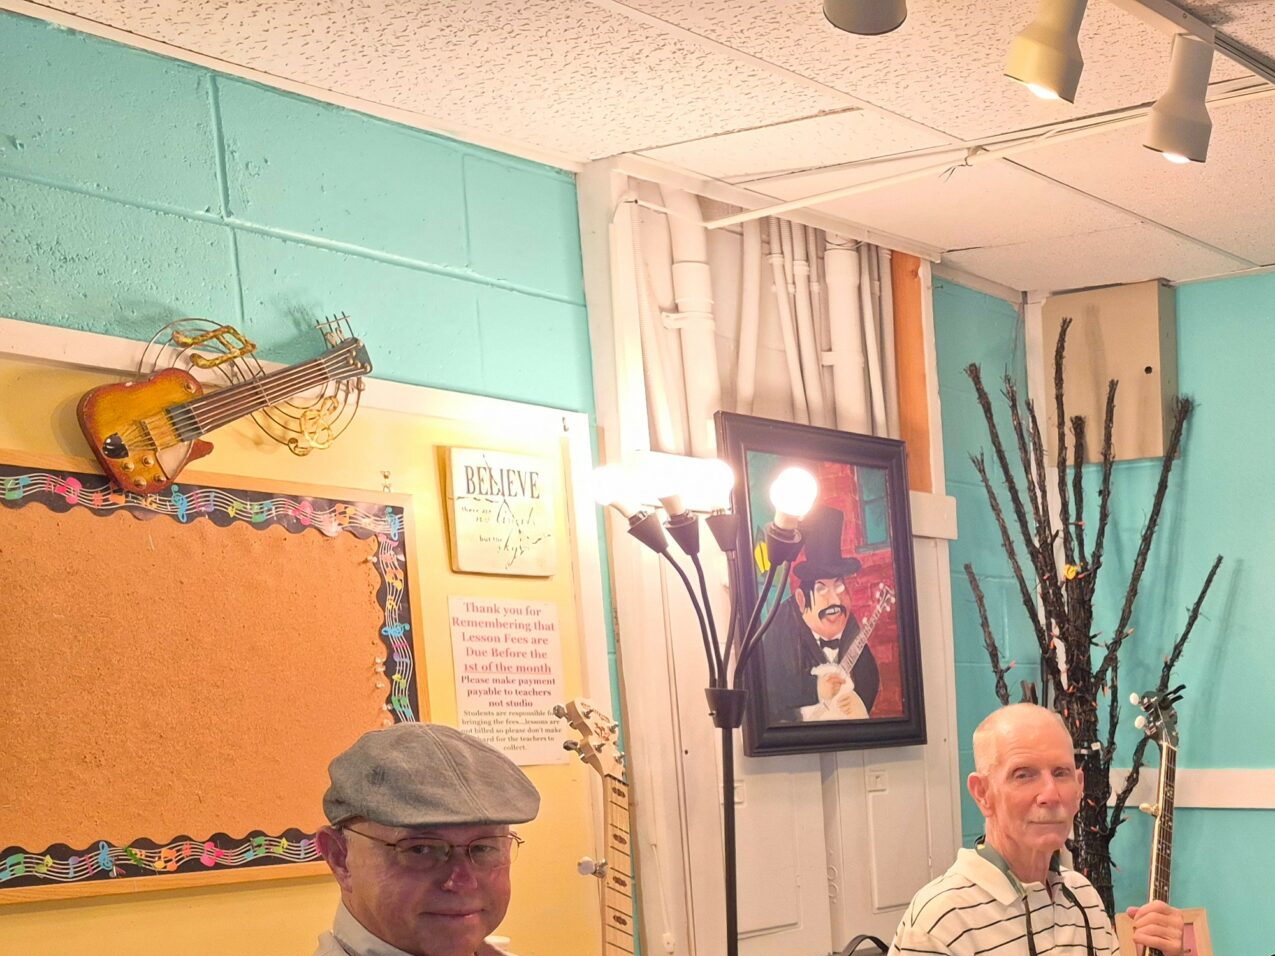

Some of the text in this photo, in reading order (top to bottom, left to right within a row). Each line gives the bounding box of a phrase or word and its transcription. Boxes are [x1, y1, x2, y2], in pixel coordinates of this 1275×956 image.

[464, 465, 540, 499] BELIEVE
[463, 602, 542, 617] Thank you for
[452, 616, 555, 632] Remembering that
[462, 632, 549, 645] Lesson Fees are
[466, 647, 547, 659] Due Before the
[464, 662, 552, 673] 1st of the month
[461, 675, 556, 687] Please make payment
[467, 688, 552, 697] payable to teachers
